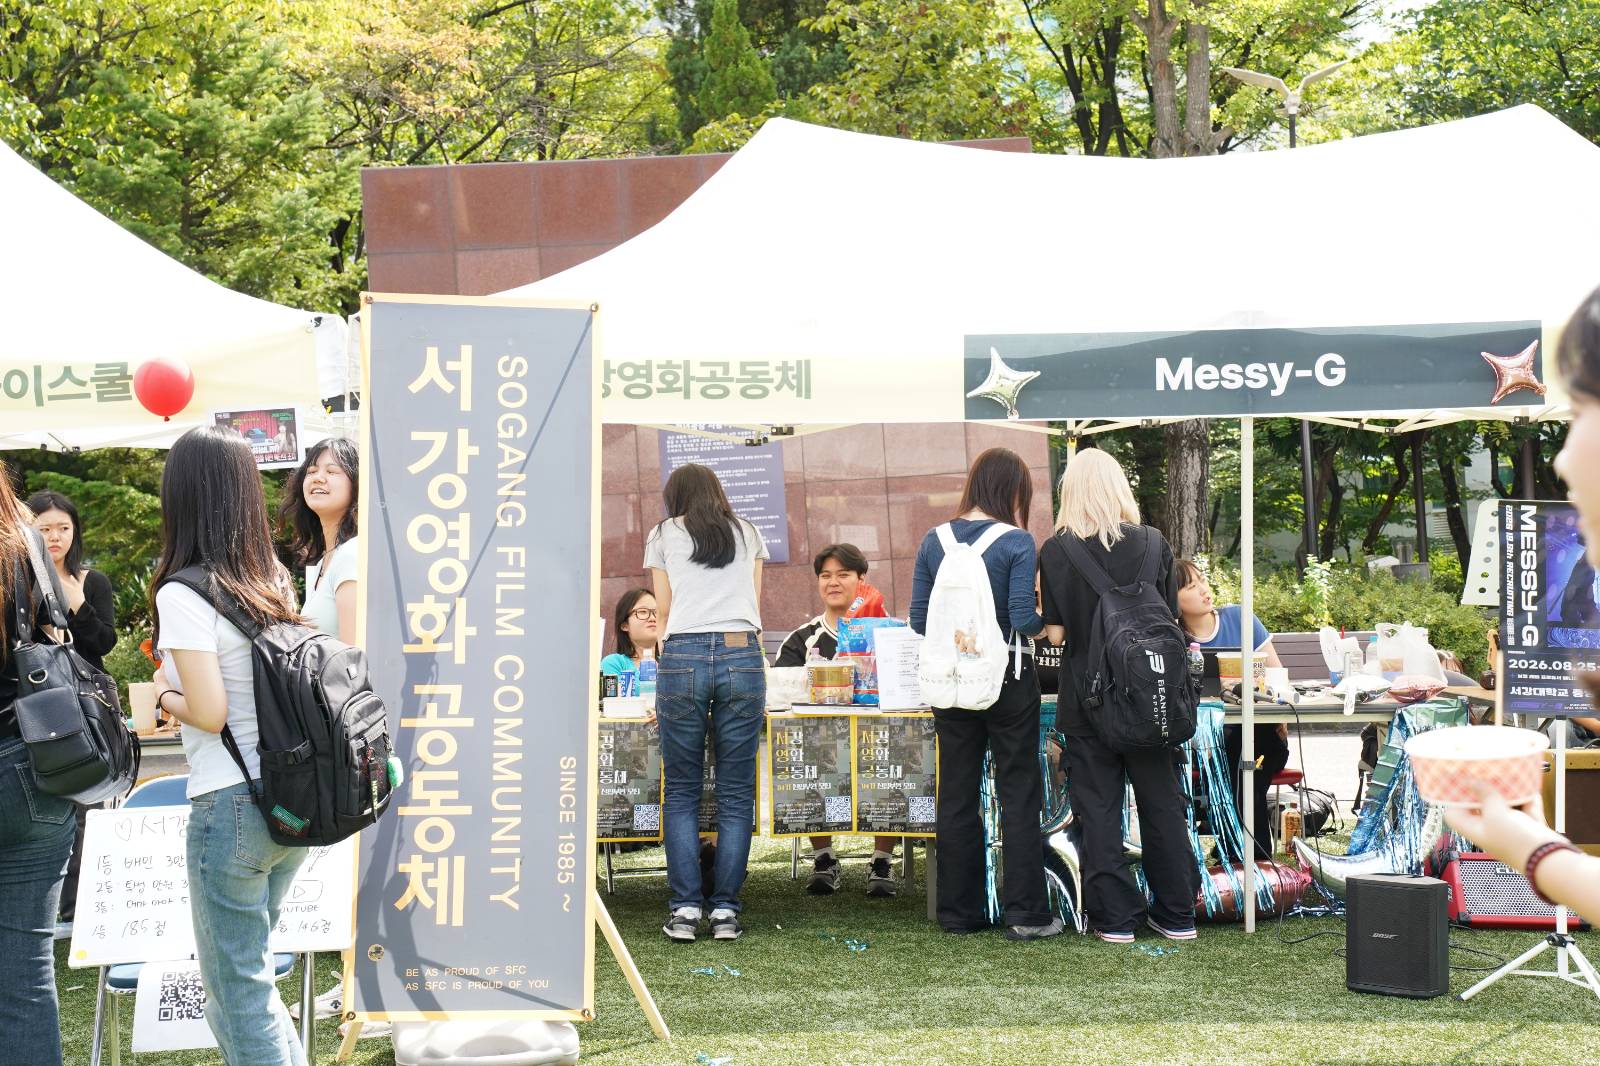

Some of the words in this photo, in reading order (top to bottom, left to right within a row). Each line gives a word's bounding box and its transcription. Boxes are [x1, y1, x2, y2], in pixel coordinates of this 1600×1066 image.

[0, 361, 133, 407] 이스쿨
[1156, 353, 1347, 397] Messy-G
[496, 355, 529, 527] SOGANG
[495, 547, 526, 635] FILM
[1520, 505, 1539, 647] MESSY-G
[394, 345, 480, 926] 서강영화공동체
[1508, 658, 1600, 672] 2026.08.25
[1509, 686, 1569, 697] 서강대학교
[1157, 679, 1169, 738] BEANPOLE
[490, 655, 525, 911] COMMUNITY
[559, 756, 577, 823] SINCE
[124, 855, 153, 870] 배민
[557, 832, 576, 885] 1985
[405, 968, 419, 977] BE
[424, 967, 439, 977] AS
[444, 966, 480, 976] PROUD
[485, 966, 499, 975] OF
[504, 965, 527, 975] SFC
[405, 982, 419, 991] AS
[424, 981, 447, 990] SFC
[452, 981, 462, 990] IS
[467, 980, 503, 990] PROUD
[508, 979, 522, 989] OF
[528, 979, 549, 989] YOU
